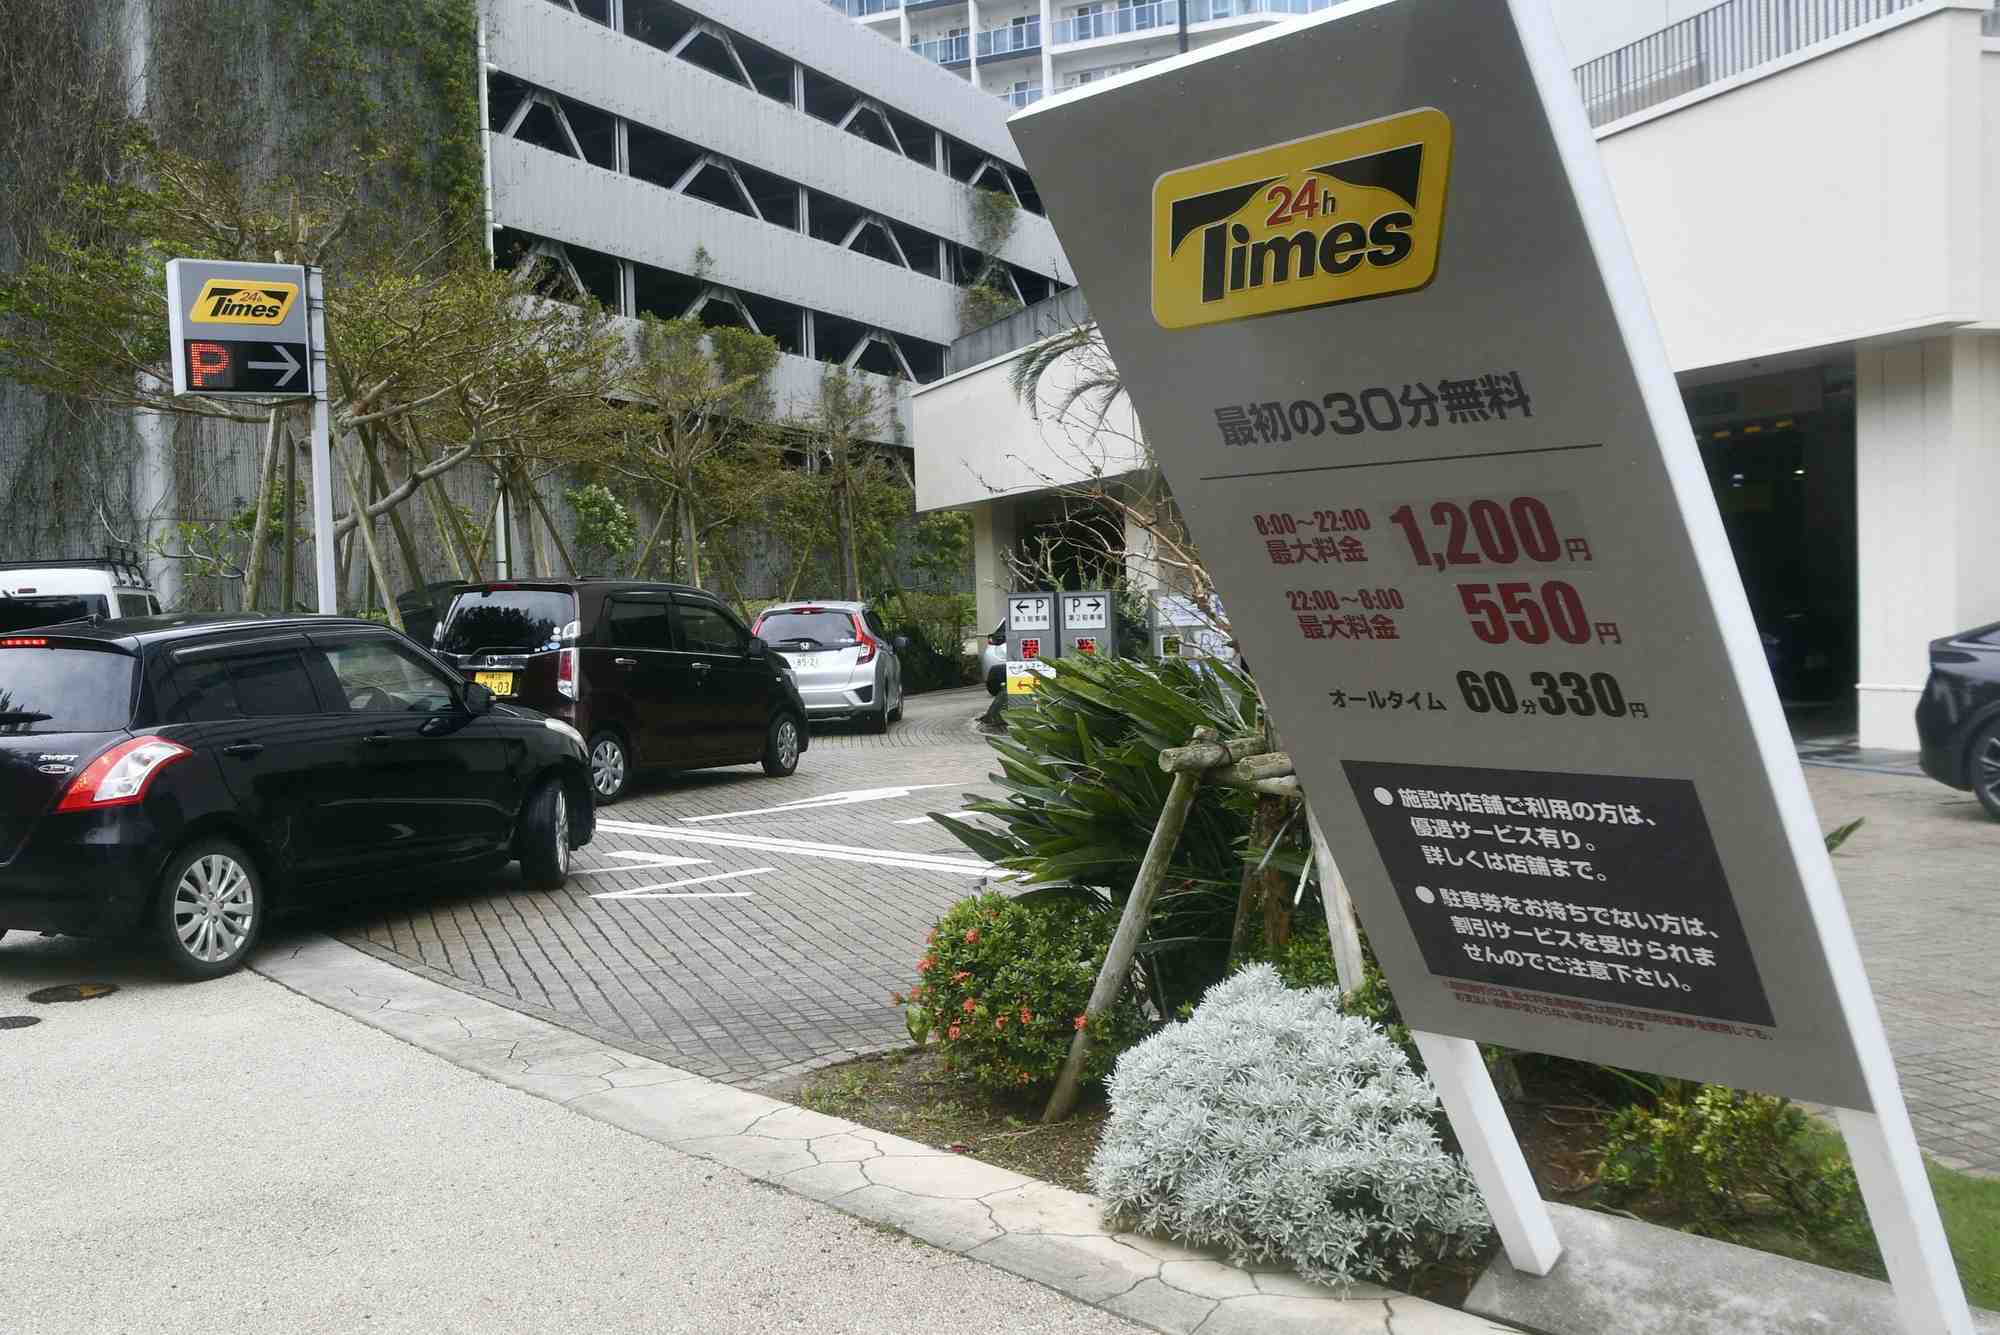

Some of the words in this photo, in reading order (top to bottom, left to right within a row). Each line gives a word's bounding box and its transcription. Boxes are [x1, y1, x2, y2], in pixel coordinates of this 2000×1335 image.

[1266, 177, 1336, 228] 24h
[1201, 211, 1414, 305] Times
[210, 296, 281, 318] Times
[191, 343, 230, 387] P
[1215, 371, 1532, 447] 最初の30分無料
[1266, 535, 1368, 564] 最大料金
[1036, 600, 1044, 613] P
[1072, 598, 1080, 612] P
[1298, 613, 1400, 640] 最大料金
[1329, 687, 1447, 712] オールタイム
[1410, 816, 1598, 852] 優遇サービス有り。
[1421, 844, 1608, 882] 詳しくは店舗まで。
[1450, 915, 1717, 968] 割引サービスを受けられま
[1462, 943, 1692, 992] せんのでご注意下さい。
